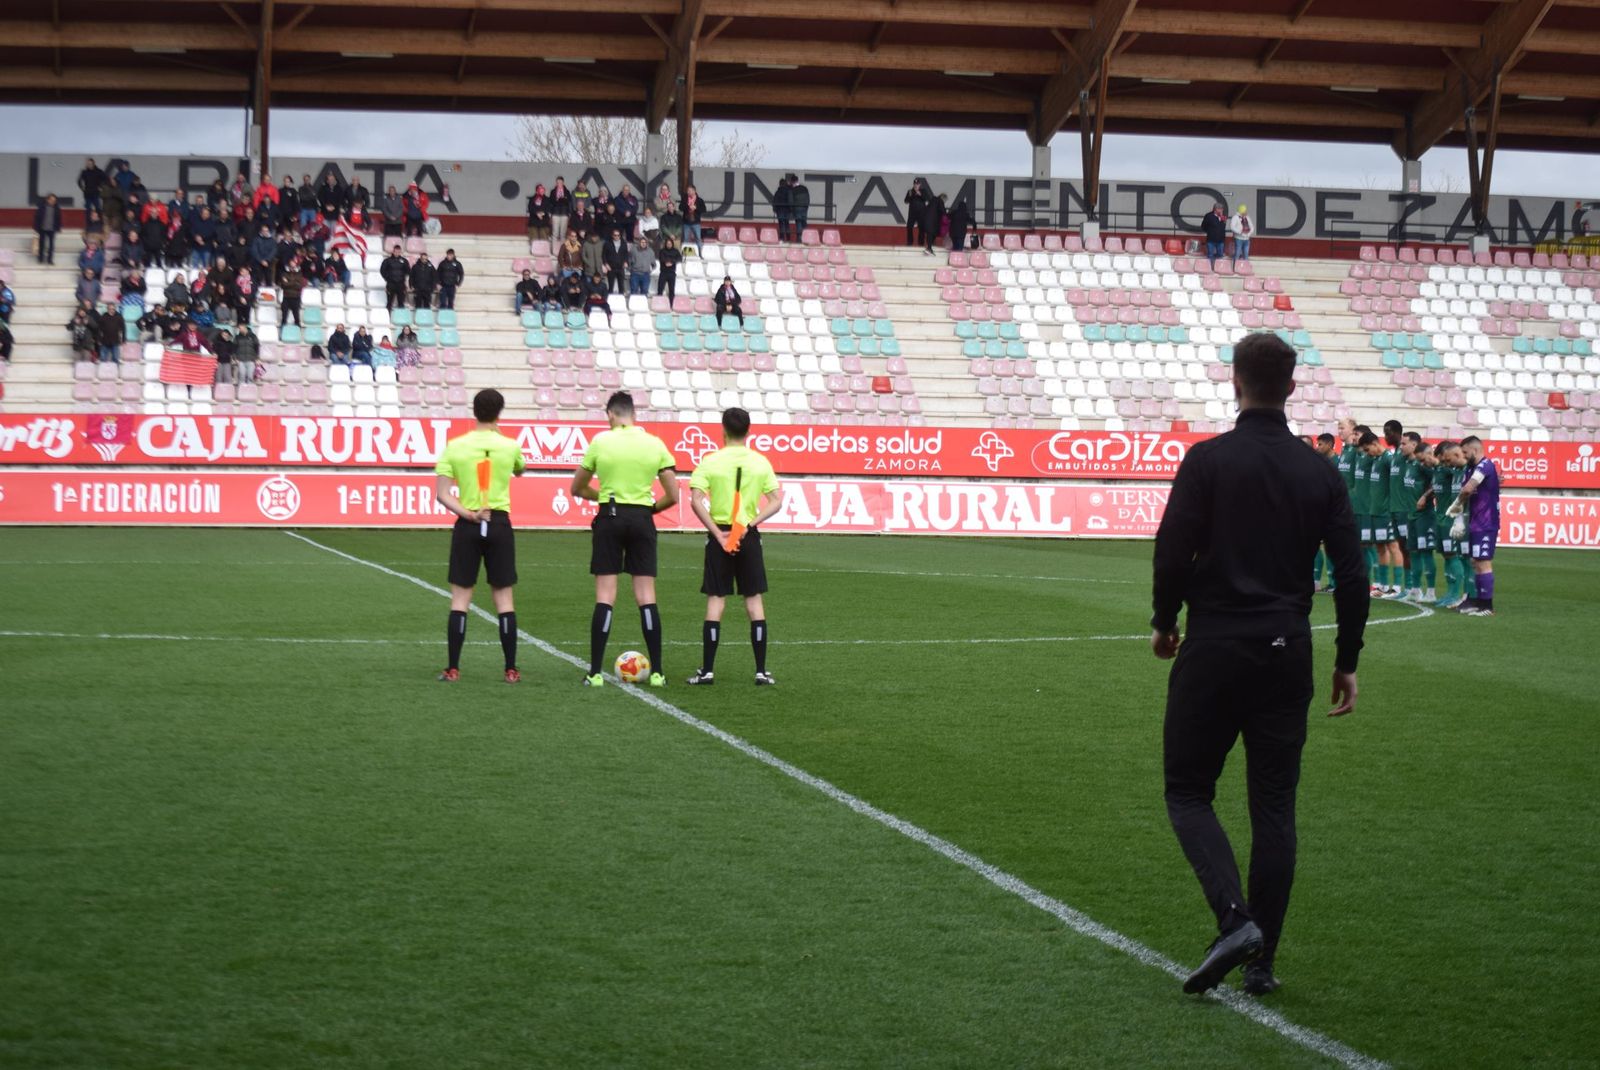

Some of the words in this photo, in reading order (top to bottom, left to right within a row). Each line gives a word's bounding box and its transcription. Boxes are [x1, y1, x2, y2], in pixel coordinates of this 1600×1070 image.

[1256, 188, 1361, 238] DE
[136, 416, 267, 461] CAJA
[280, 418, 451, 463] RURAL
[516, 426, 590, 455] AMA
[745, 428, 868, 454] recoletas
[875, 430, 942, 455] salud
[1487, 445, 1546, 455] PEDIA
[863, 458, 942, 471] ZAMORA
[1048, 462, 1117, 471] EMBUTIDOS
[1130, 463, 1178, 472] JAMONE
[80, 479, 220, 513] FEDERACIÓN
[756, 482, 875, 529] AJA
[884, 483, 1072, 532] RURAL
[1106, 490, 1170, 506] TERN
[1540, 503, 1598, 517] DENTA
[1509, 522, 1537, 544] DE
